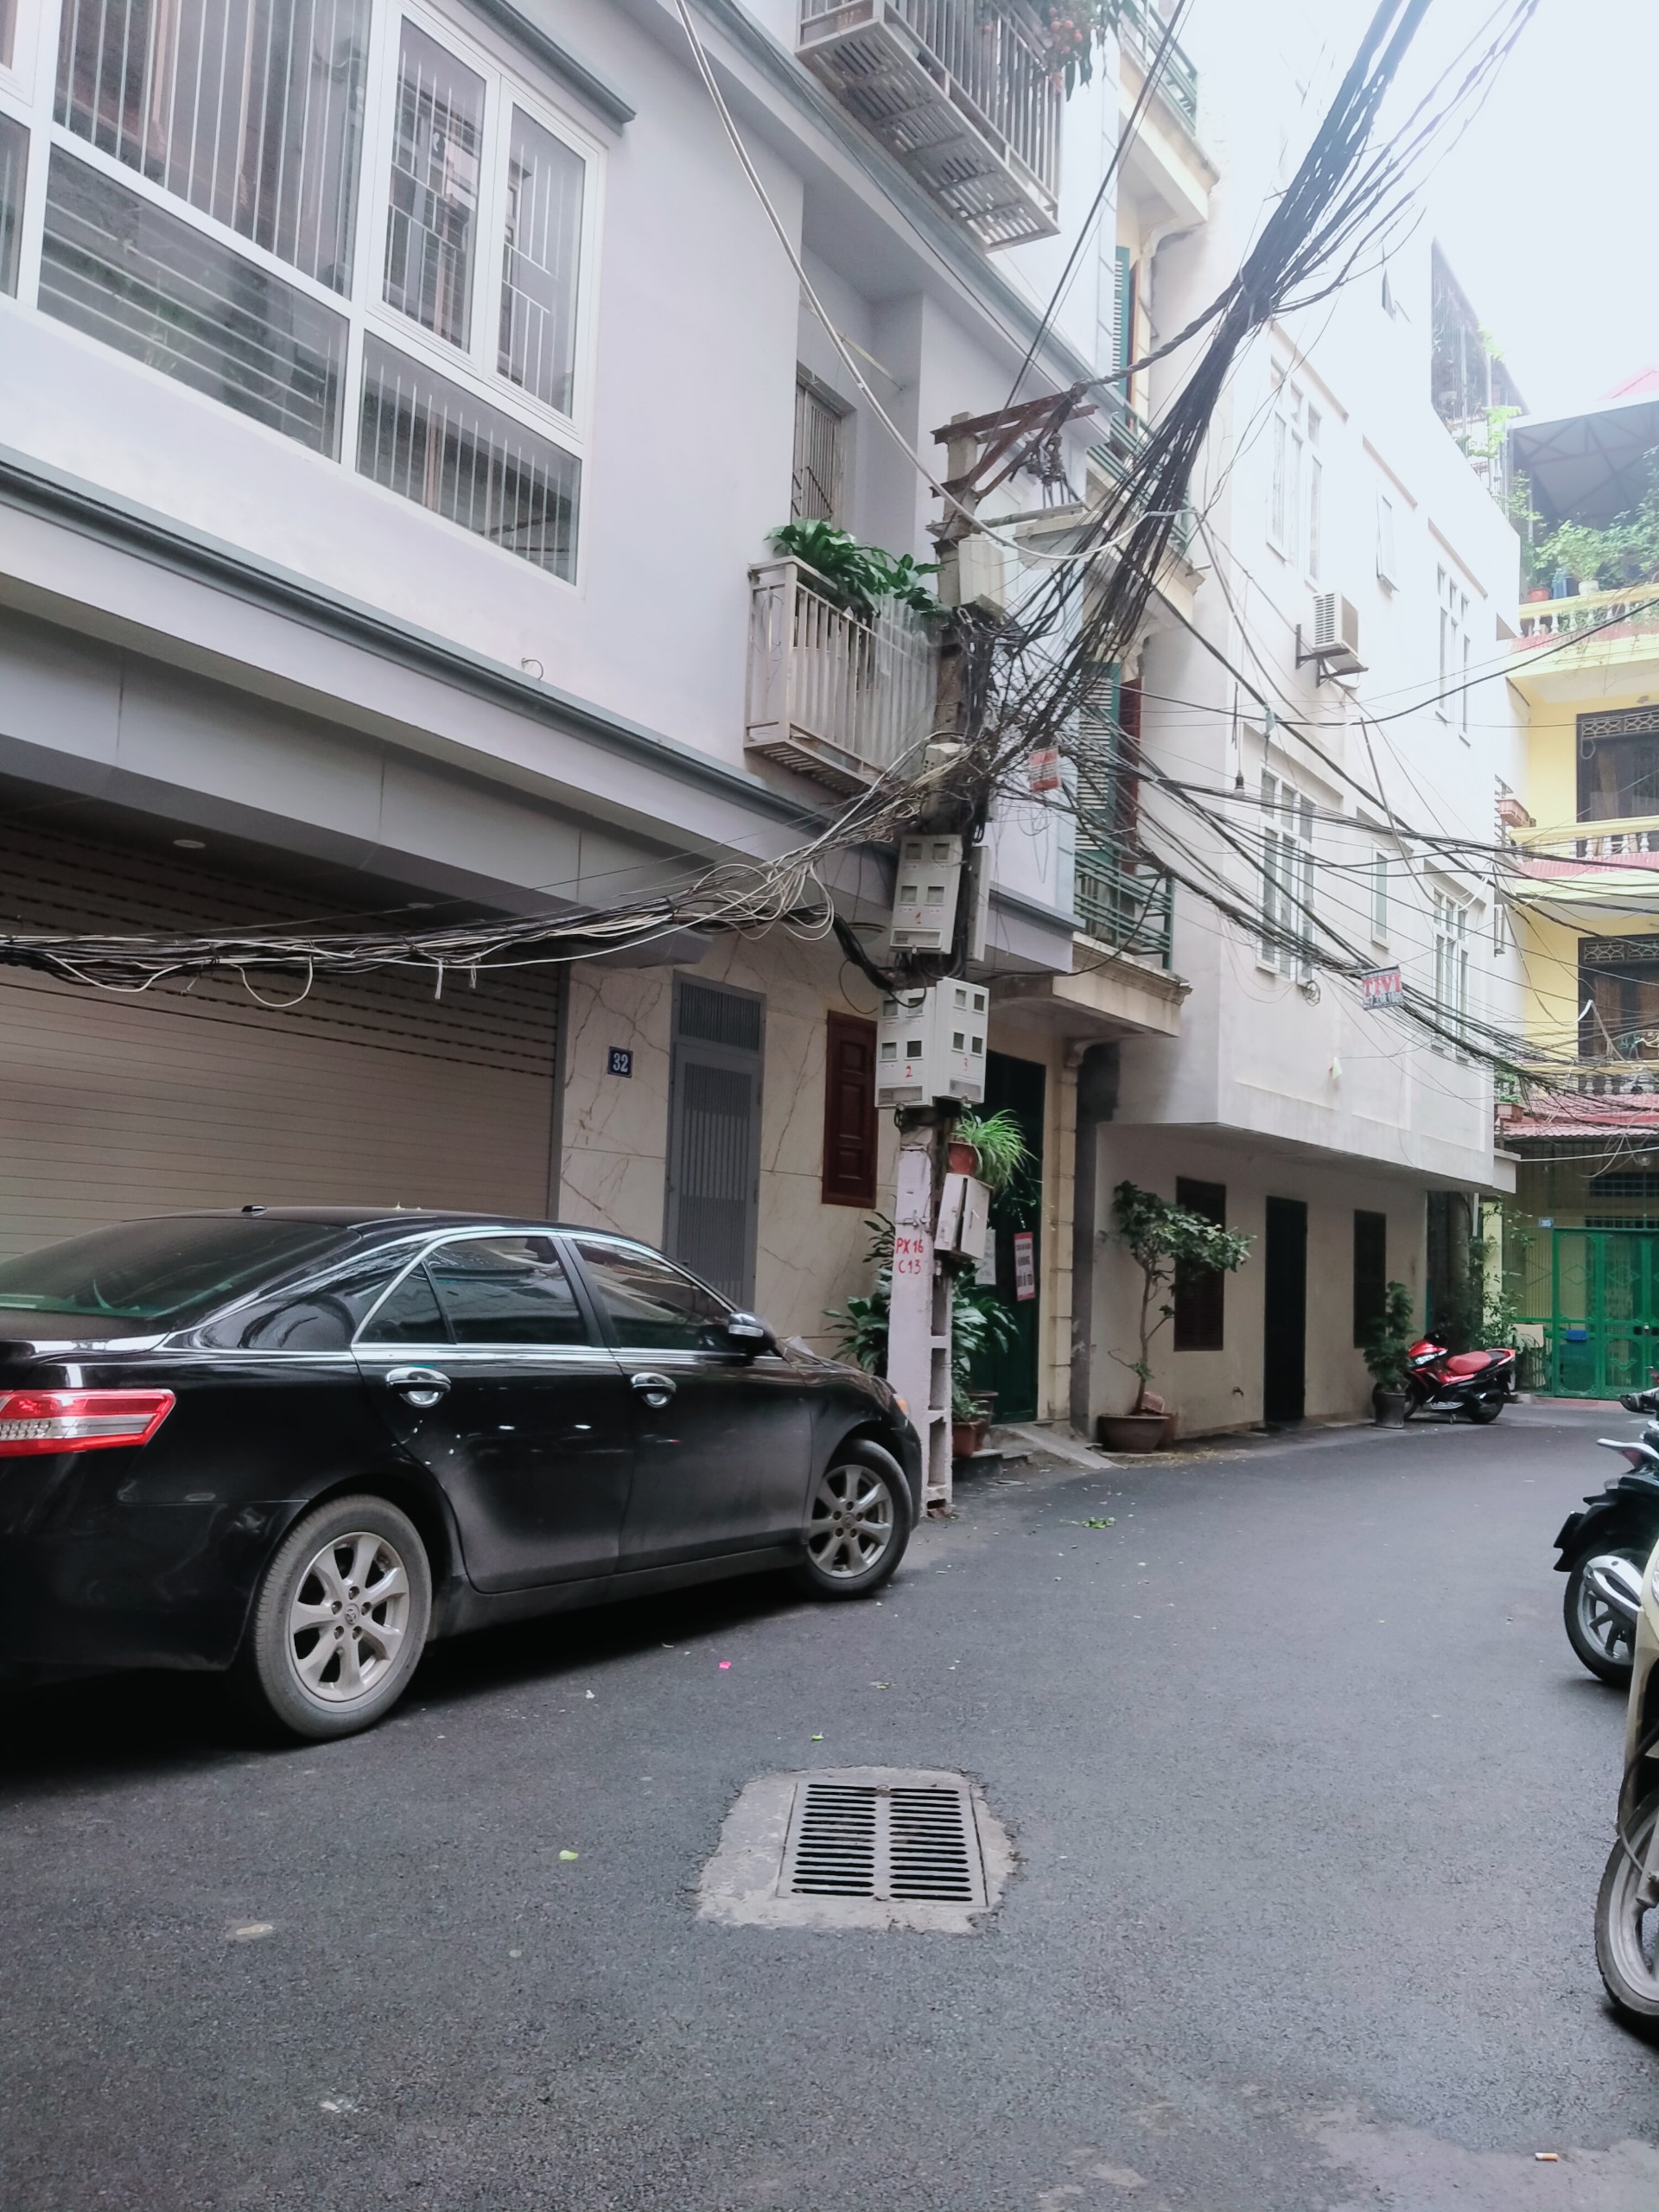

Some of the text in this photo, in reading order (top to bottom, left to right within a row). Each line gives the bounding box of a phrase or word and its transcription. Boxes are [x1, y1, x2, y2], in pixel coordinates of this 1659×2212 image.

[913, 912, 922, 925] 1
[1363, 973, 1402, 996] TIVI
[613, 1052, 629, 1073] 32
[905, 1065, 913, 1078] 2
[895, 1236, 924, 1254] PX 16
